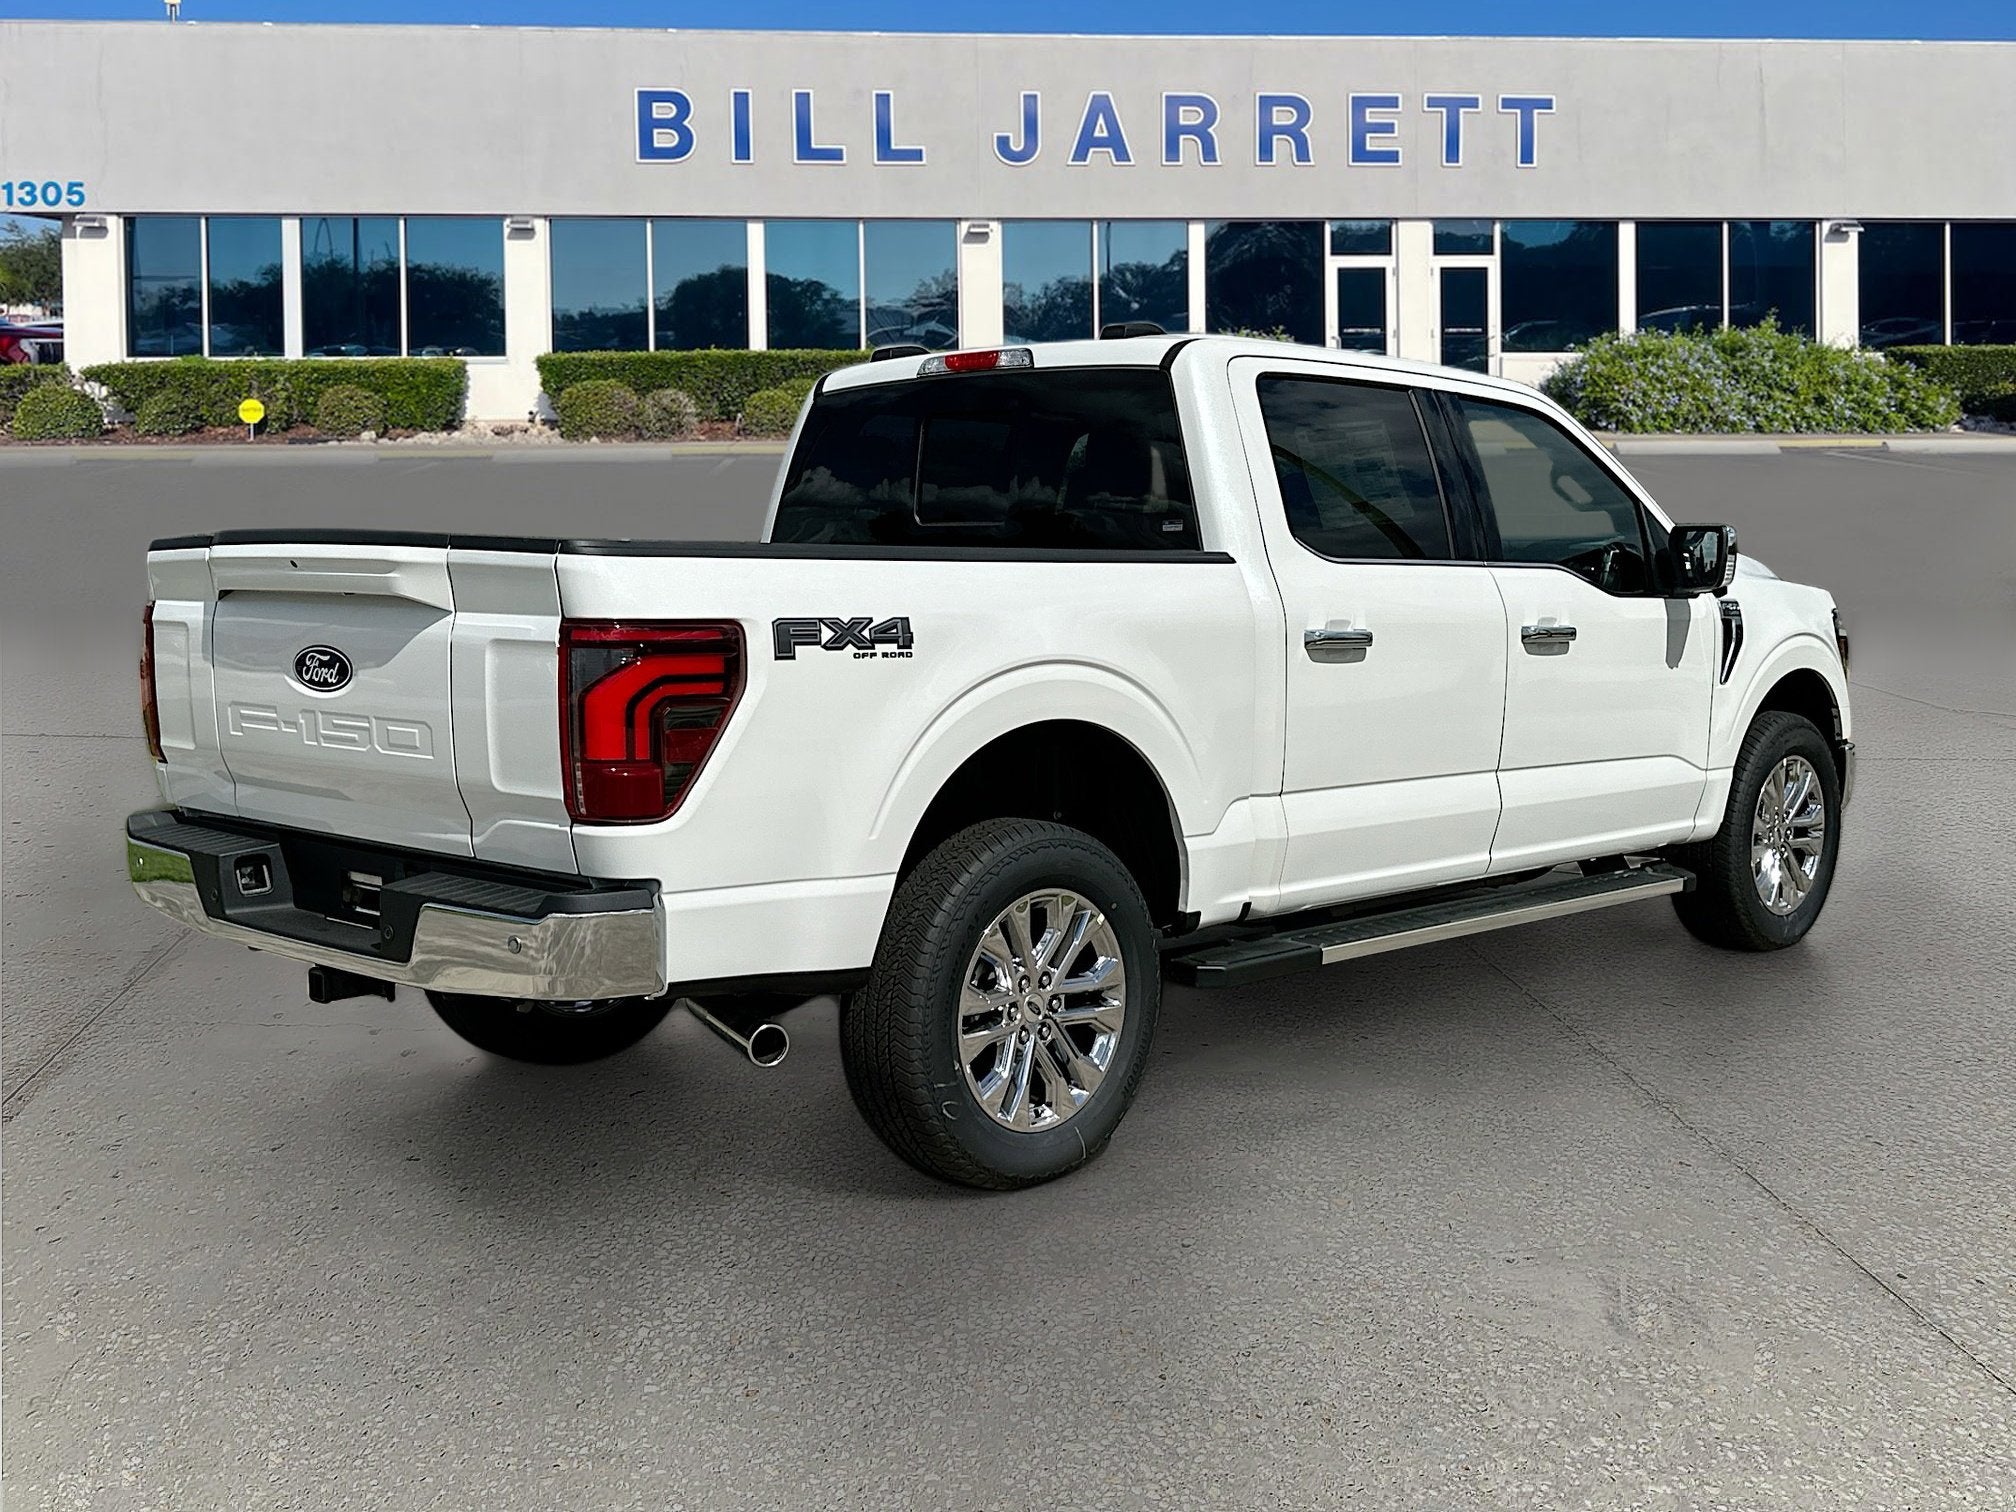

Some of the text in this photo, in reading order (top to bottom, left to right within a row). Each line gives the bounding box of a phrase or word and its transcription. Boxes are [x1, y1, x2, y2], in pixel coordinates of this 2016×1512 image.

[634, 87, 1556, 168] BILL JARRETT
[1, 181, 85, 207] 1305
[772, 617, 914, 660] FX4
[881, 651, 913, 659] ROAD
[302, 652, 340, 684] Ford
[228, 701, 434, 760] F-150
